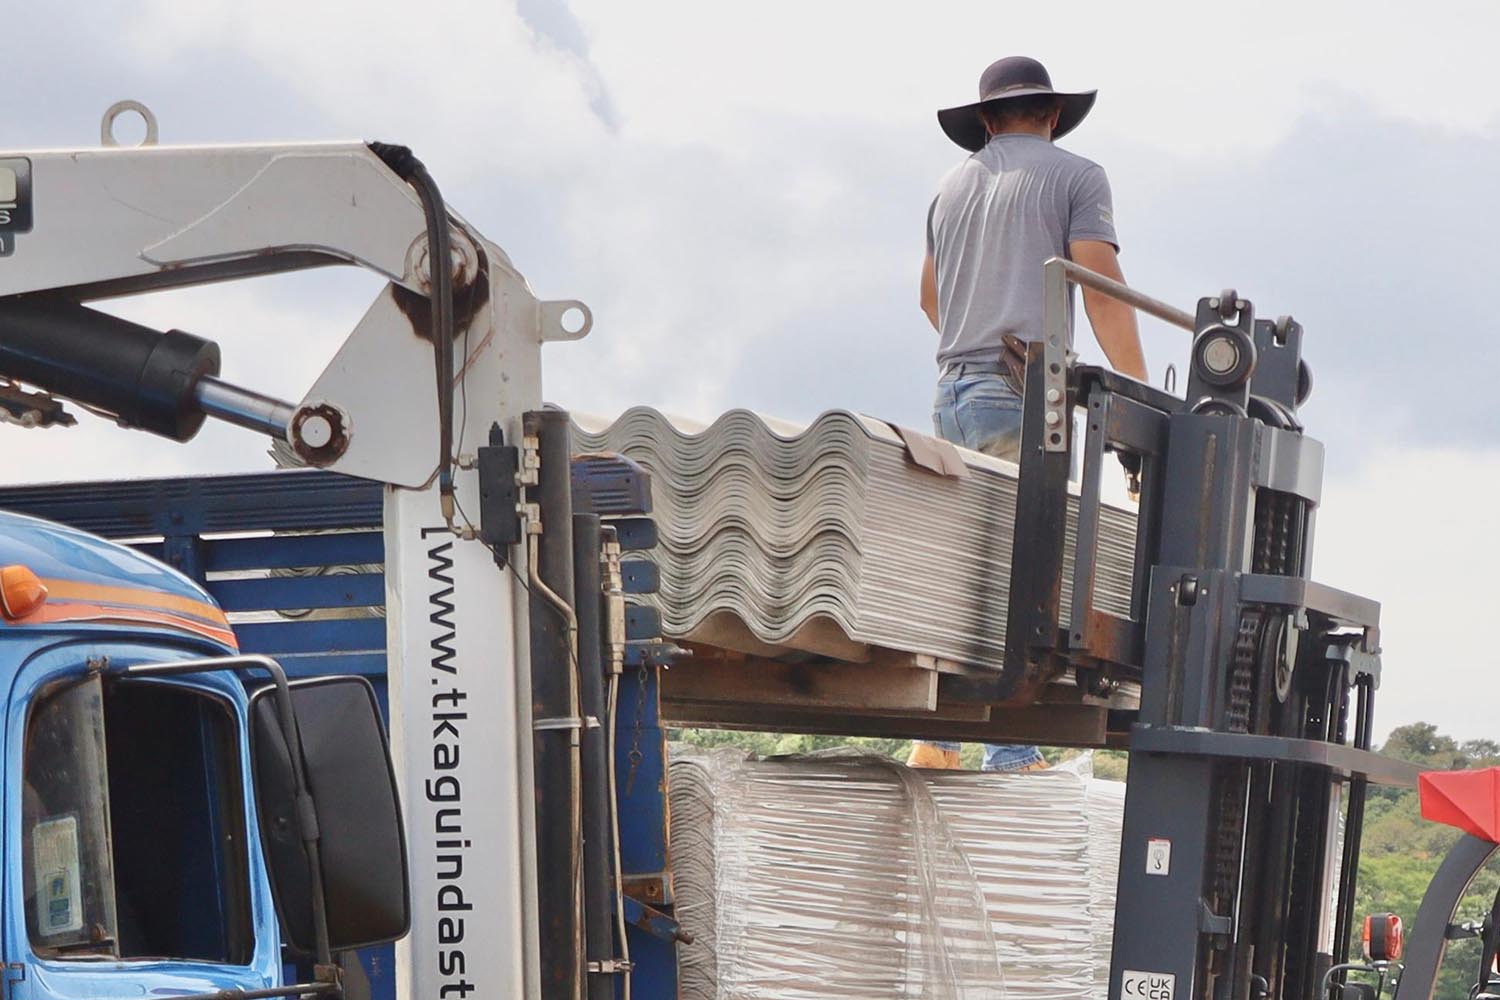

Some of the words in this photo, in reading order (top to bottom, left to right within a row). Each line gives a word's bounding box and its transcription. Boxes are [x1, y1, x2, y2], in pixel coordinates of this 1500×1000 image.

[1124, 978, 1147, 997] CE
[1150, 977, 1171, 990] UK
[1149, 989, 1171, 1000] CA
